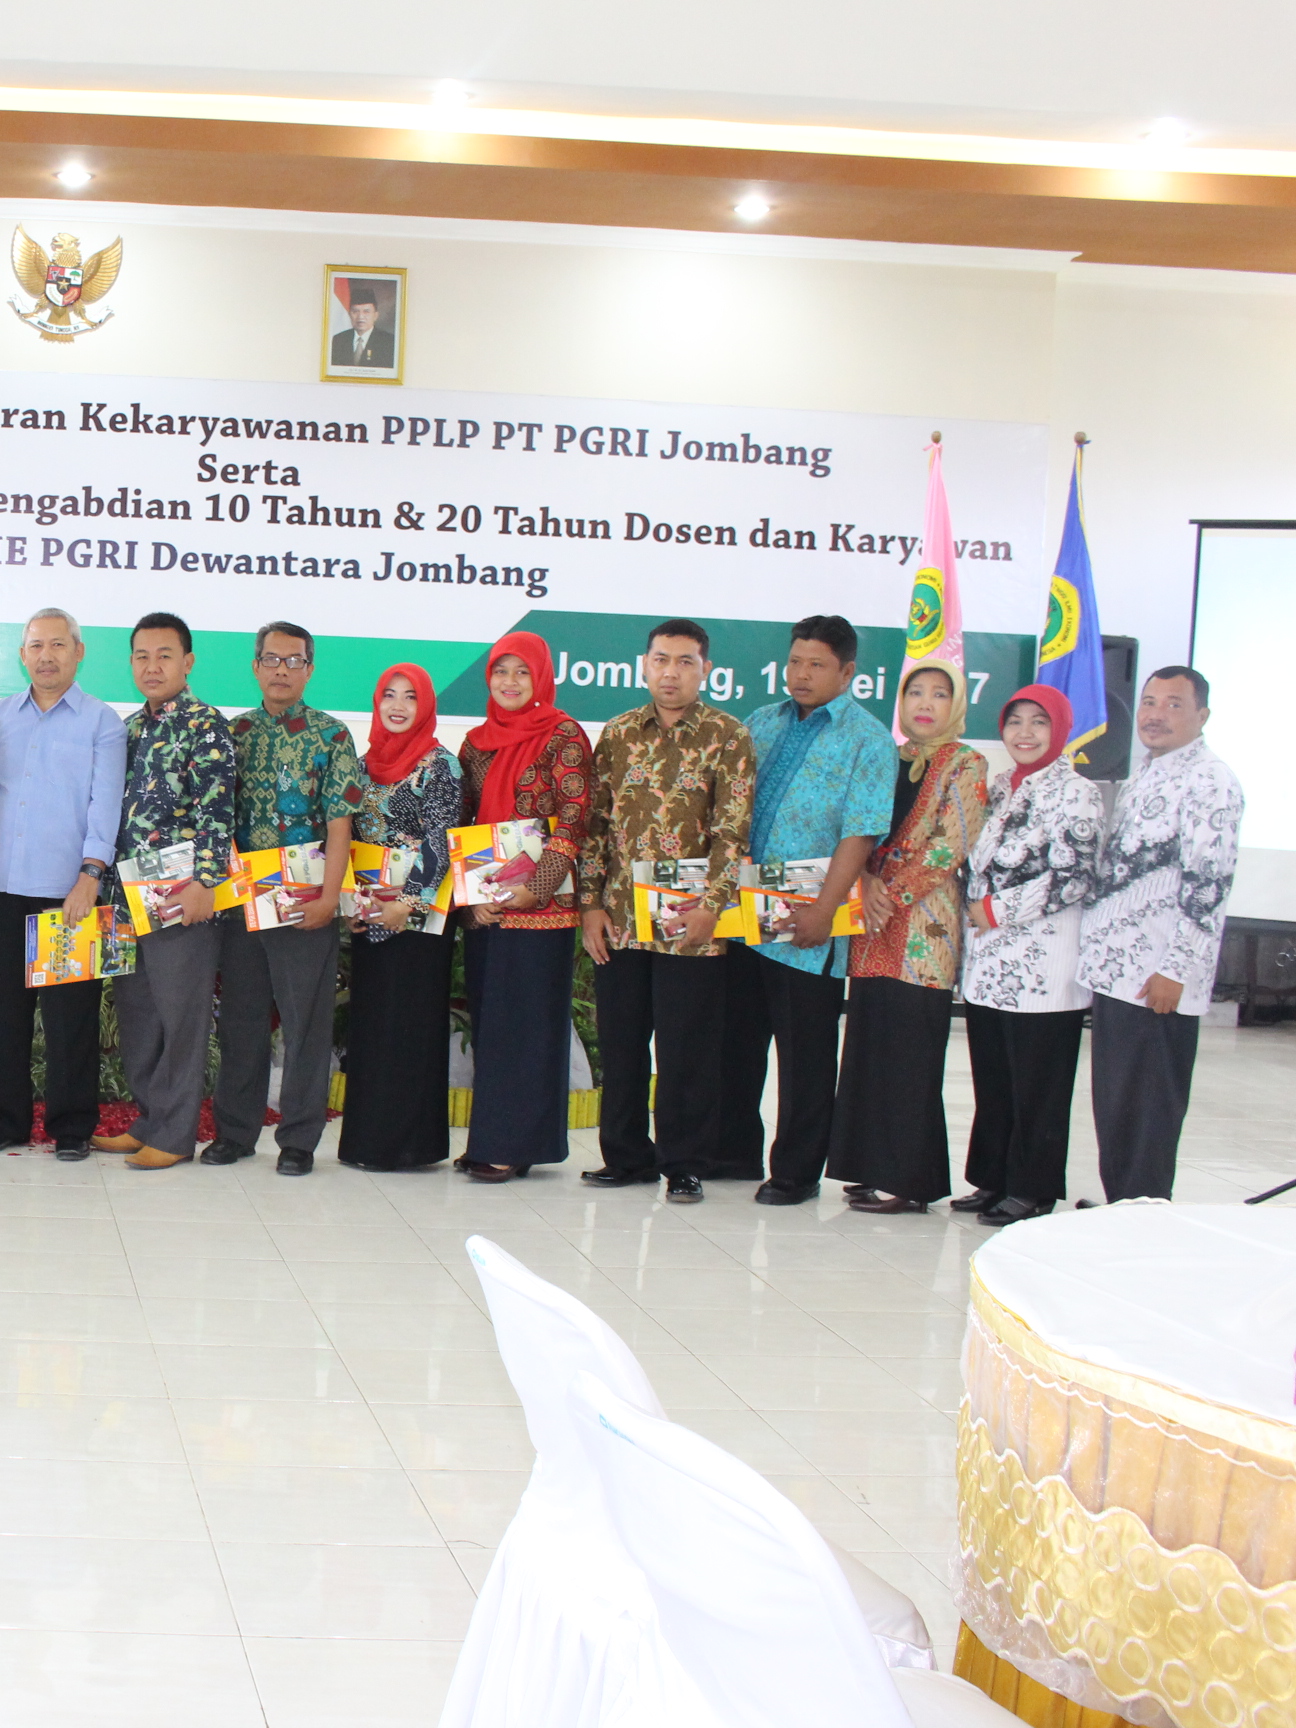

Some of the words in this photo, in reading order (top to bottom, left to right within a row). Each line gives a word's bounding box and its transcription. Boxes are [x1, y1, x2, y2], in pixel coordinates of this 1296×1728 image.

[79, 402, 369, 447] Kekaryawanan
[381, 415, 481, 449] PPLP
[491, 421, 543, 452] PT
[553, 424, 650, 458] PGRI
[659, 430, 833, 479] Jombang
[196, 453, 301, 487] Serta
[205, 493, 251, 523] 10
[261, 494, 383, 529] Tahun
[393, 501, 426, 531] &
[436, 503, 482, 534] 20
[493, 505, 612, 540] Tahun
[623, 512, 738, 547] Dosen
[748, 517, 817, 551] dan
[828, 523, 1013, 566] Karyan
[40, 537, 139, 570] PGRI
[150, 541, 362, 580] Dewantara
[372, 551, 550, 599] Jombang
